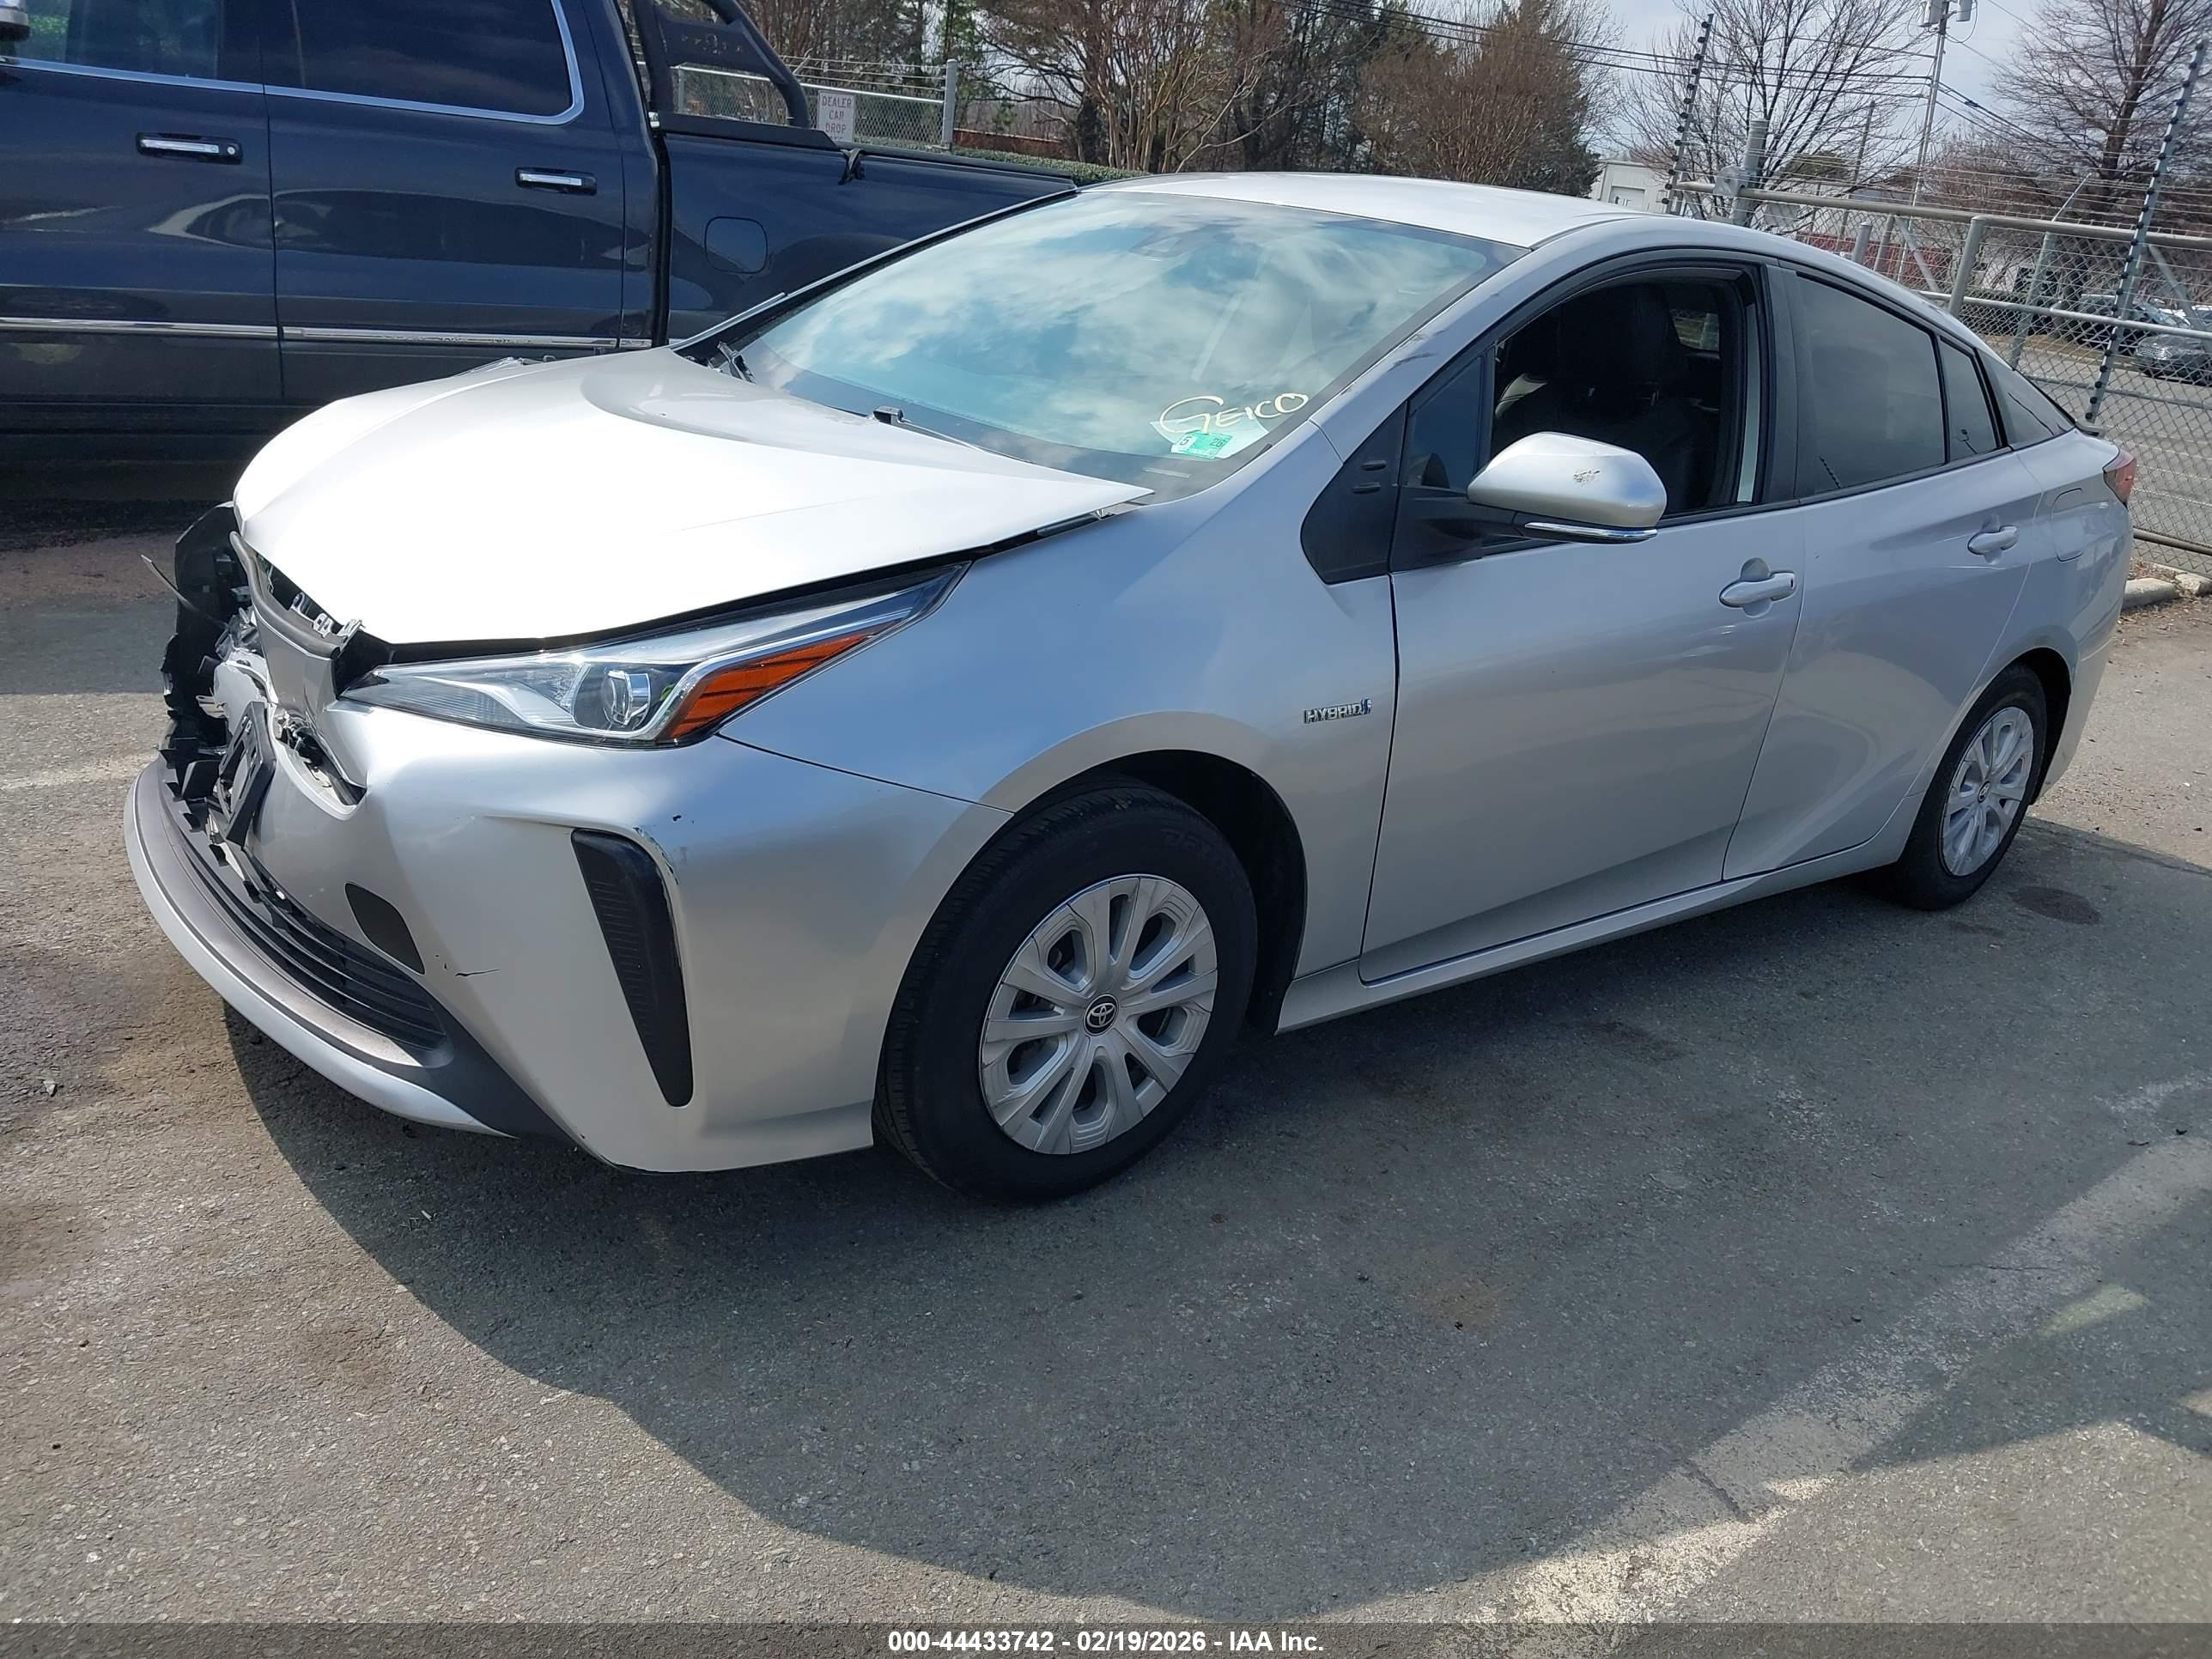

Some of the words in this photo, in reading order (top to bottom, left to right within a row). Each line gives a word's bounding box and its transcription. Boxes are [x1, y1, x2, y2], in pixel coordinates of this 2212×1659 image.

[822, 95, 852, 108] DEALER
[825, 122, 847, 134] DROP
[1304, 702, 1362, 724] HYBRID
